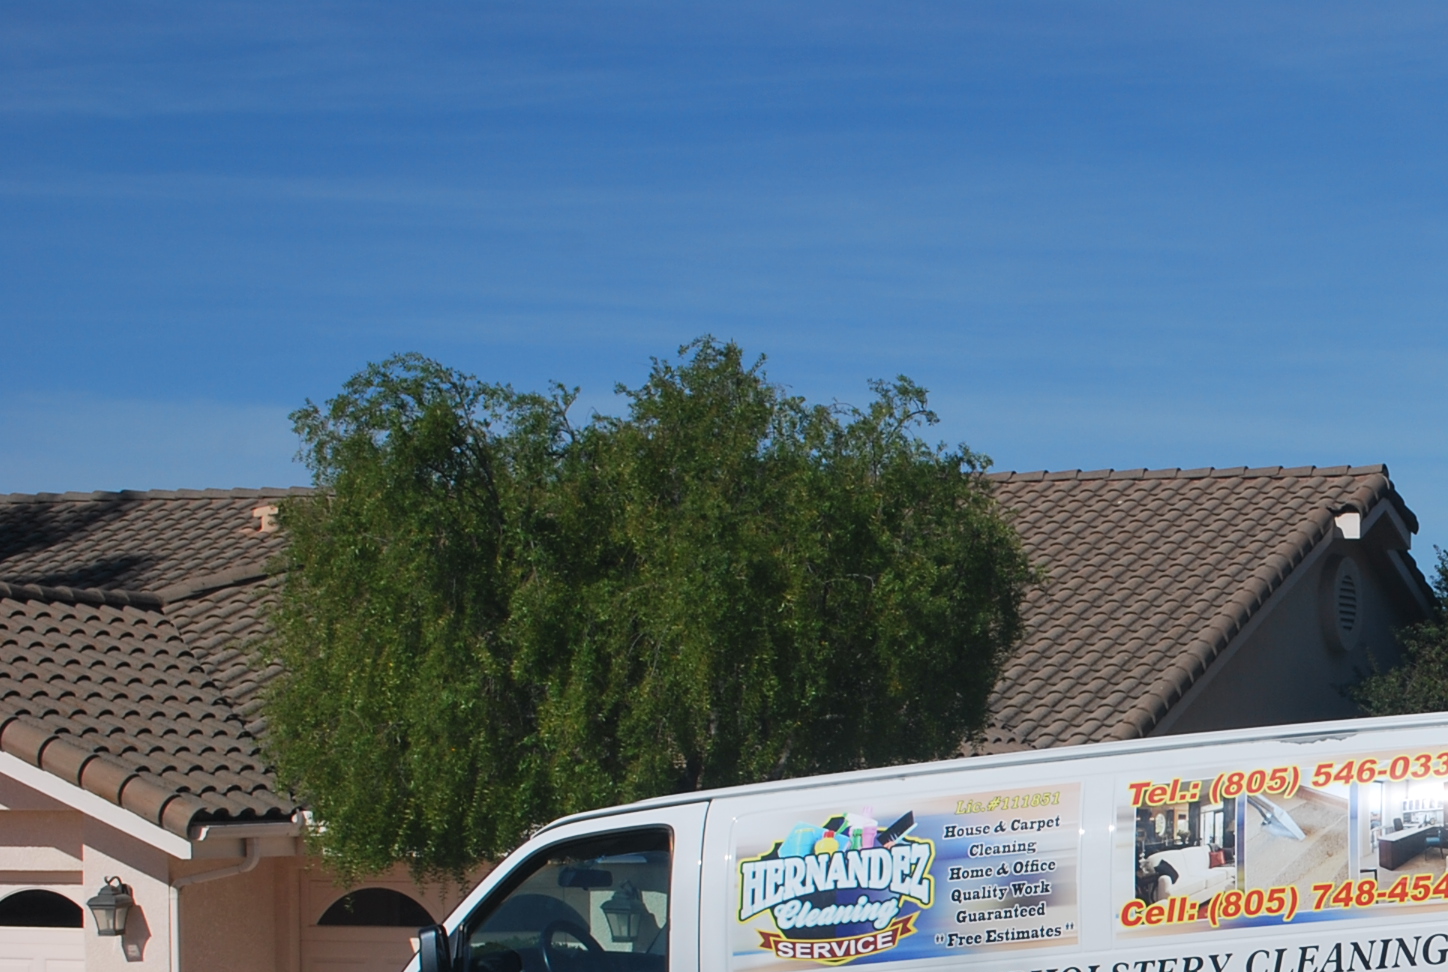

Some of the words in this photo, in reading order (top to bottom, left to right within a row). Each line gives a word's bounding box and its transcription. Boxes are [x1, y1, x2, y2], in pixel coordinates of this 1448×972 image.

[1129, 780, 1200, 806] Tel.:
[1209, 766, 1300, 803] (805)
[944, 825, 990, 838] House
[994, 821, 1006, 832] &
[1011, 815, 1061, 831] Carpet
[969, 841, 1037, 857] Cleaning
[740, 843, 931, 921] HERNANDEZ
[949, 867, 993, 880] Home
[996, 863, 1009, 876] &
[1013, 860, 1056, 874] Office
[951, 886, 1008, 904] Quality
[1011, 881, 1051, 896] Work
[773, 895, 899, 930] Cleaning
[956, 903, 1046, 924] Guaranteed
[1120, 896, 1198, 927] Cell:
[1209, 886, 1299, 925] (805)
[777, 931, 894, 959] SERVICE
